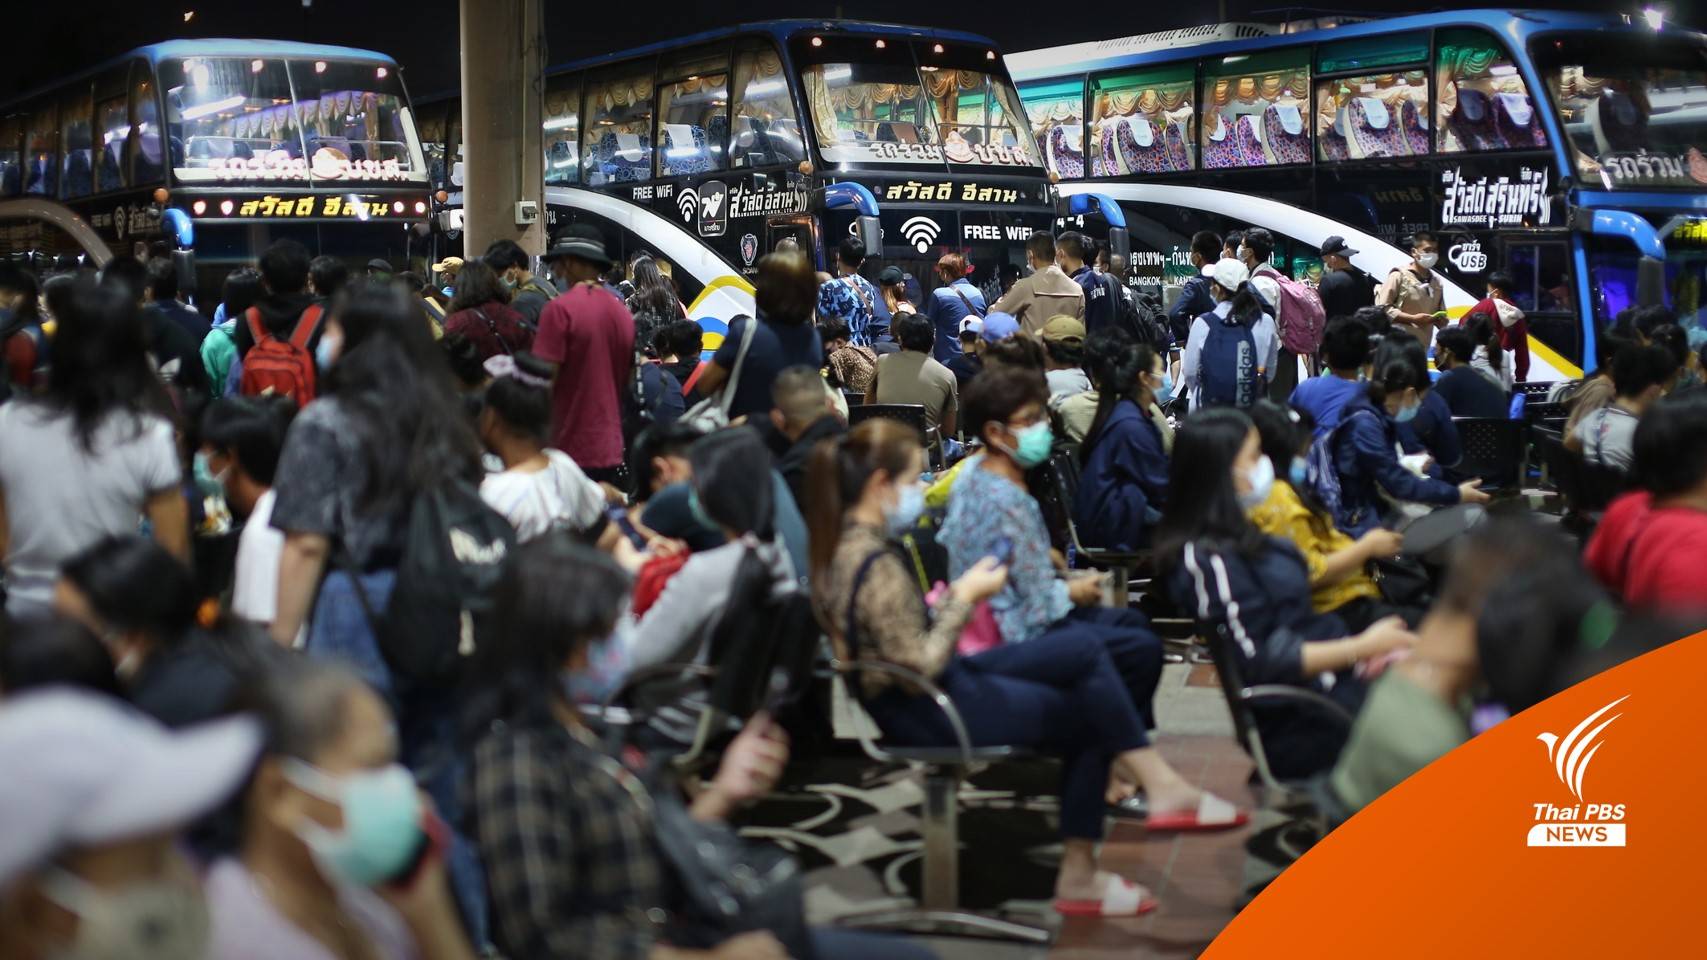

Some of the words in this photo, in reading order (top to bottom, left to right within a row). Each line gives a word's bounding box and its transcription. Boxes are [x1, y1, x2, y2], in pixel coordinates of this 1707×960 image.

[868, 139, 941, 160] รถร่วม
[1605, 148, 1684, 179] รถร่วม
[632, 186, 653, 200] FREE
[656, 184, 673, 199] WiFi
[730, 182, 764, 218] สวัสดี
[886, 181, 952, 200] สวัสดี
[961, 183, 1018, 203] อีสาน
[239, 196, 315, 216] สวัสดี
[963, 225, 1002, 240] FREE
[1006, 225, 1033, 241] WiFi
[1461, 255, 1486, 268] USB
[1129, 277, 1161, 286] BANGKOK
[1239, 347, 1252, 405] adidas
